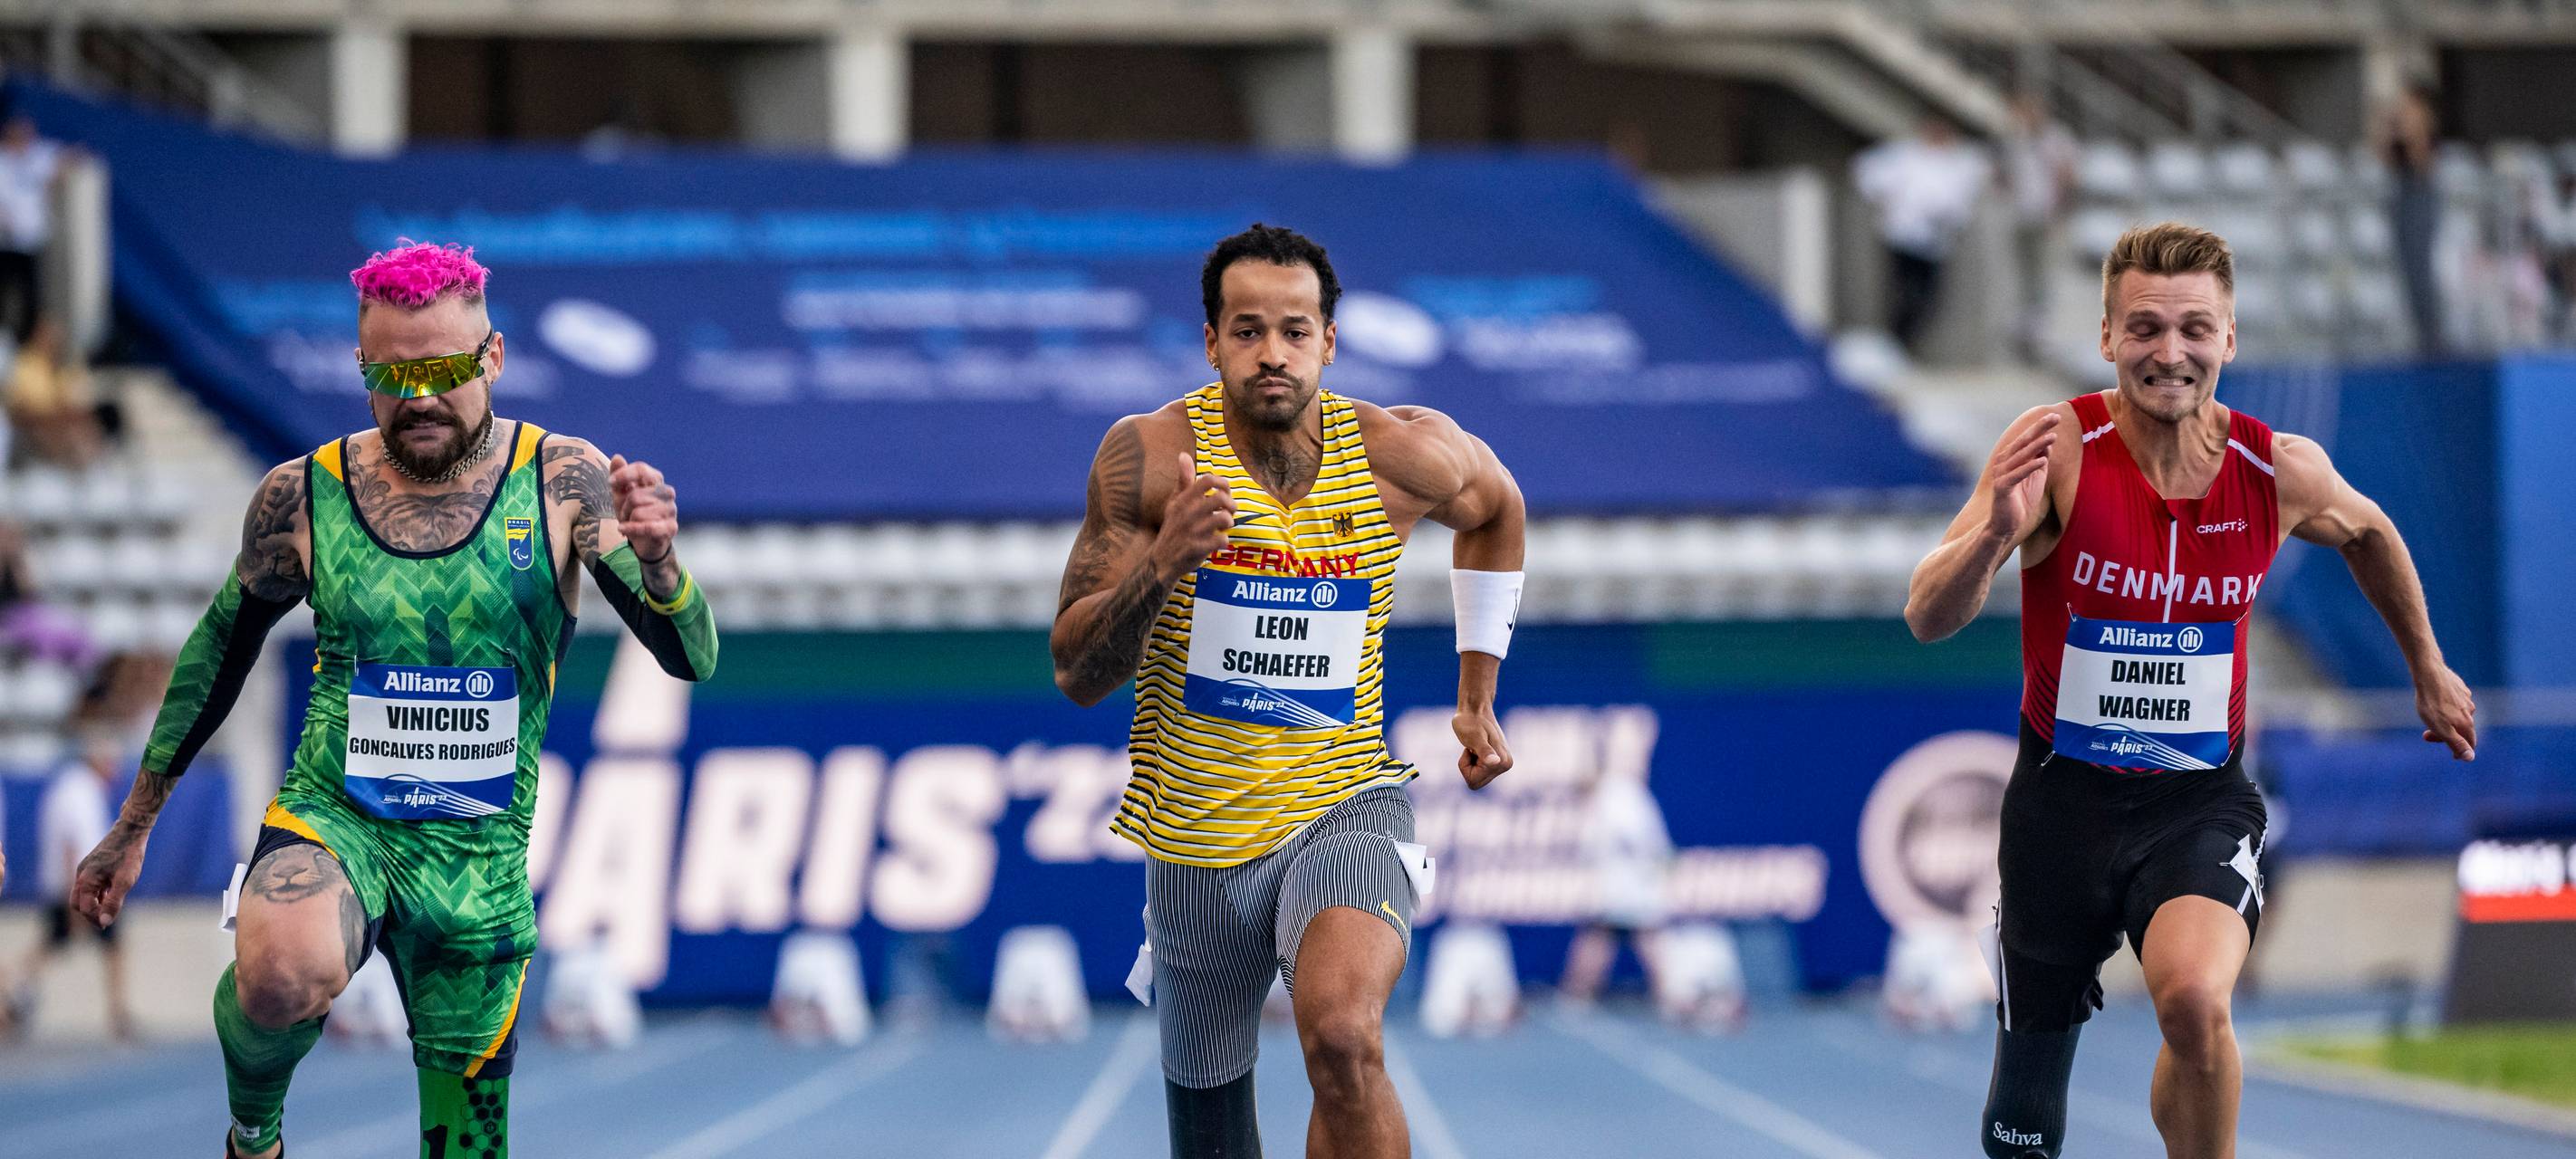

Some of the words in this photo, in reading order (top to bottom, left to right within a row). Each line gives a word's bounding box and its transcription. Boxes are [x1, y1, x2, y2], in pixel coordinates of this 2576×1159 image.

[2196, 521, 2237, 534] CRAFT
[1210, 544, 1361, 579] GERMANY
[2072, 551, 2263, 606] DENMARK
[1232, 580, 1307, 602] Allianz
[1254, 616, 1309, 640] LEON
[2099, 627, 2173, 648] Allianz
[1223, 648, 1331, 678] SCHAEFER
[2110, 659, 2186, 685] DANIEL
[384, 671, 461, 693] Allianz
[386, 705, 490, 733] VINICIUS
[2099, 694, 2191, 722] WAGNER
[349, 737, 435, 760] GONCALVES
[438, 737, 515, 761] RODRIGUES
[1993, 1121, 2043, 1145] Sahva
